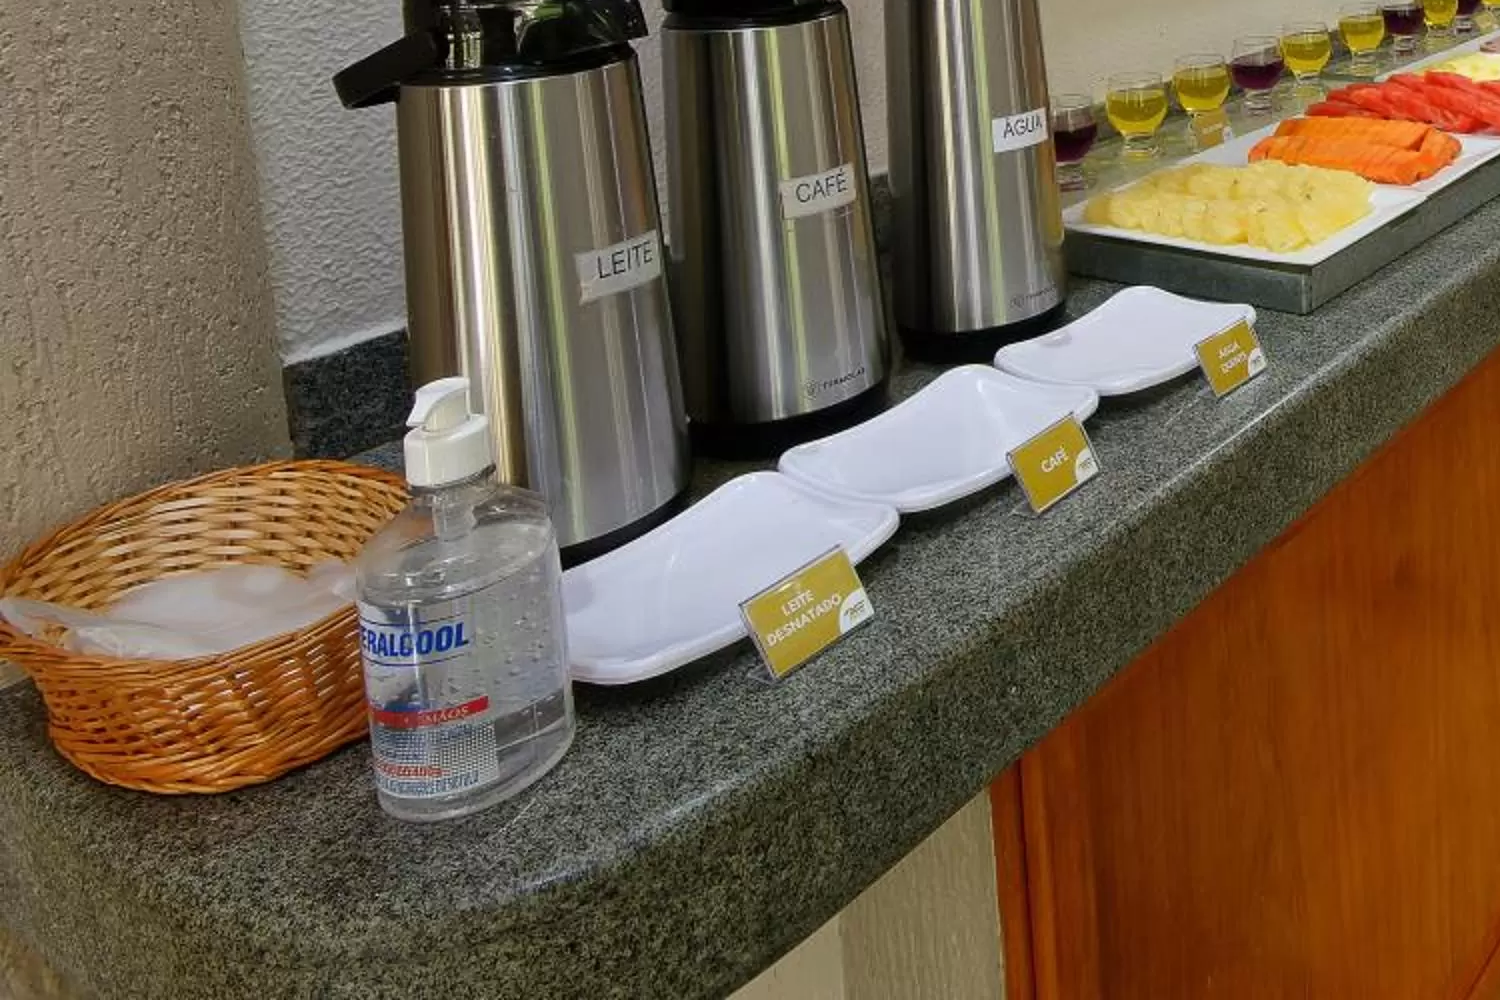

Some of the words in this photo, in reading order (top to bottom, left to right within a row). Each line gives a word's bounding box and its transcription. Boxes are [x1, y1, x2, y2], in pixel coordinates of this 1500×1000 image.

[796, 167, 848, 204] CAFÉ
[598, 240, 654, 279] LEITE
[766, 593, 842, 647] DESNATADO
[781, 589, 815, 617] LEITE
